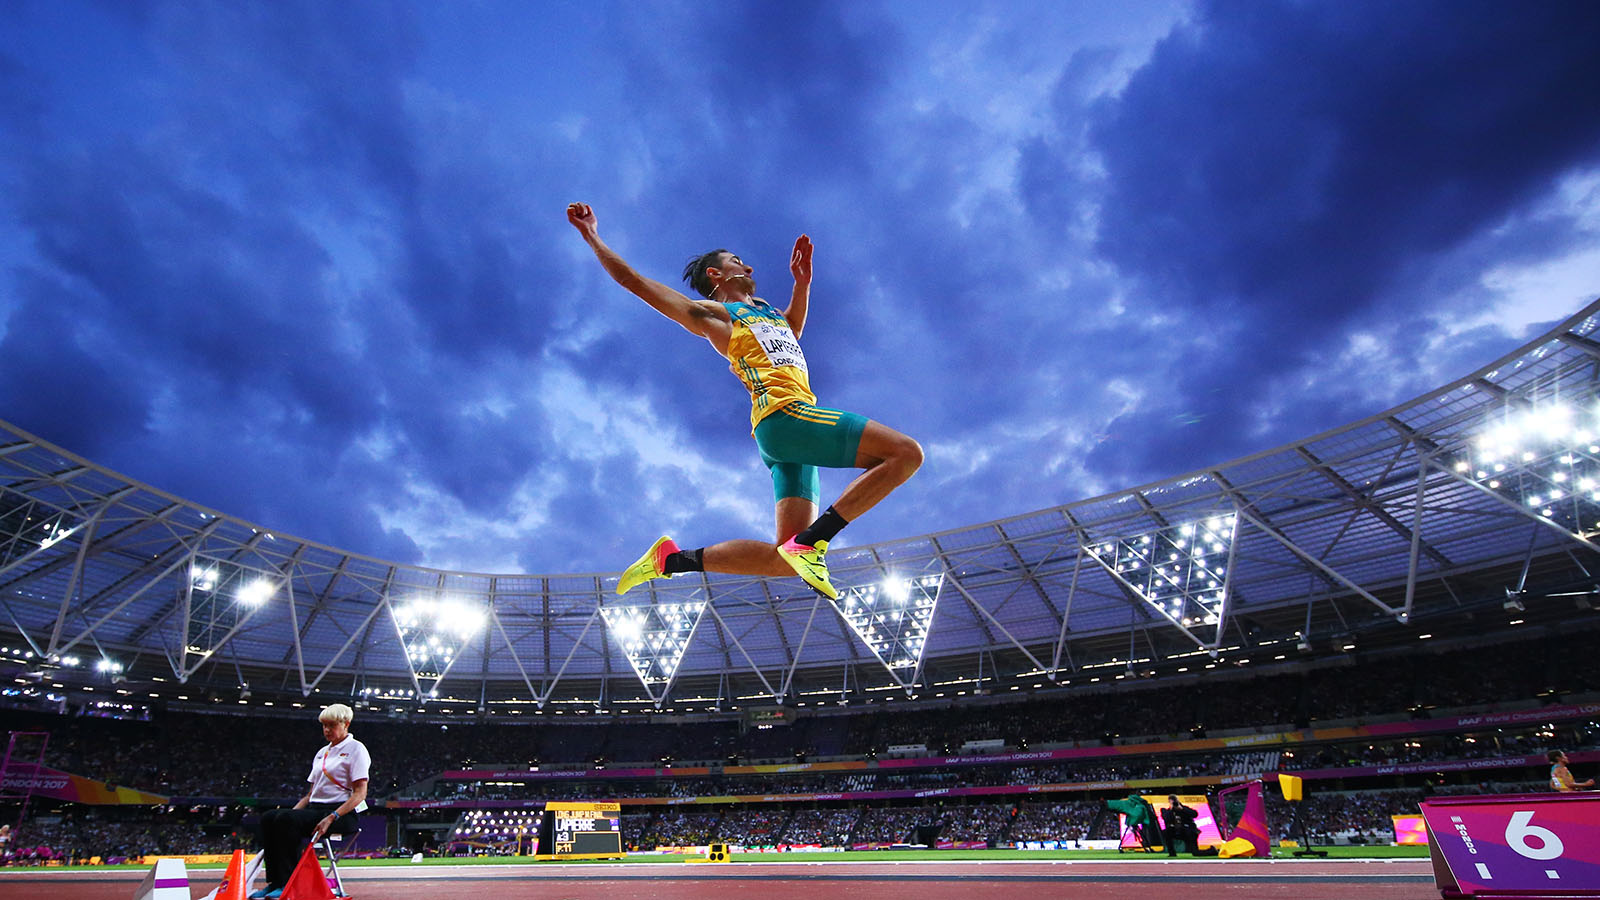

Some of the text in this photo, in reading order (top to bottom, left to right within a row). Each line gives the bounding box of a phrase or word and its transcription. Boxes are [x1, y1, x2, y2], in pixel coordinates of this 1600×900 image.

[1458, 717, 1481, 725] IAAF
[1580, 705, 1600, 713] LON
[1468, 760, 1505, 768] LONDON
[1506, 758, 1525, 766] 2017
[2, 780, 68, 789] ONDON 2017
[555, 819, 596, 832] LAPIERRE
[1454, 824, 1477, 854] MONDO
[1505, 811, 1564, 860] 6
